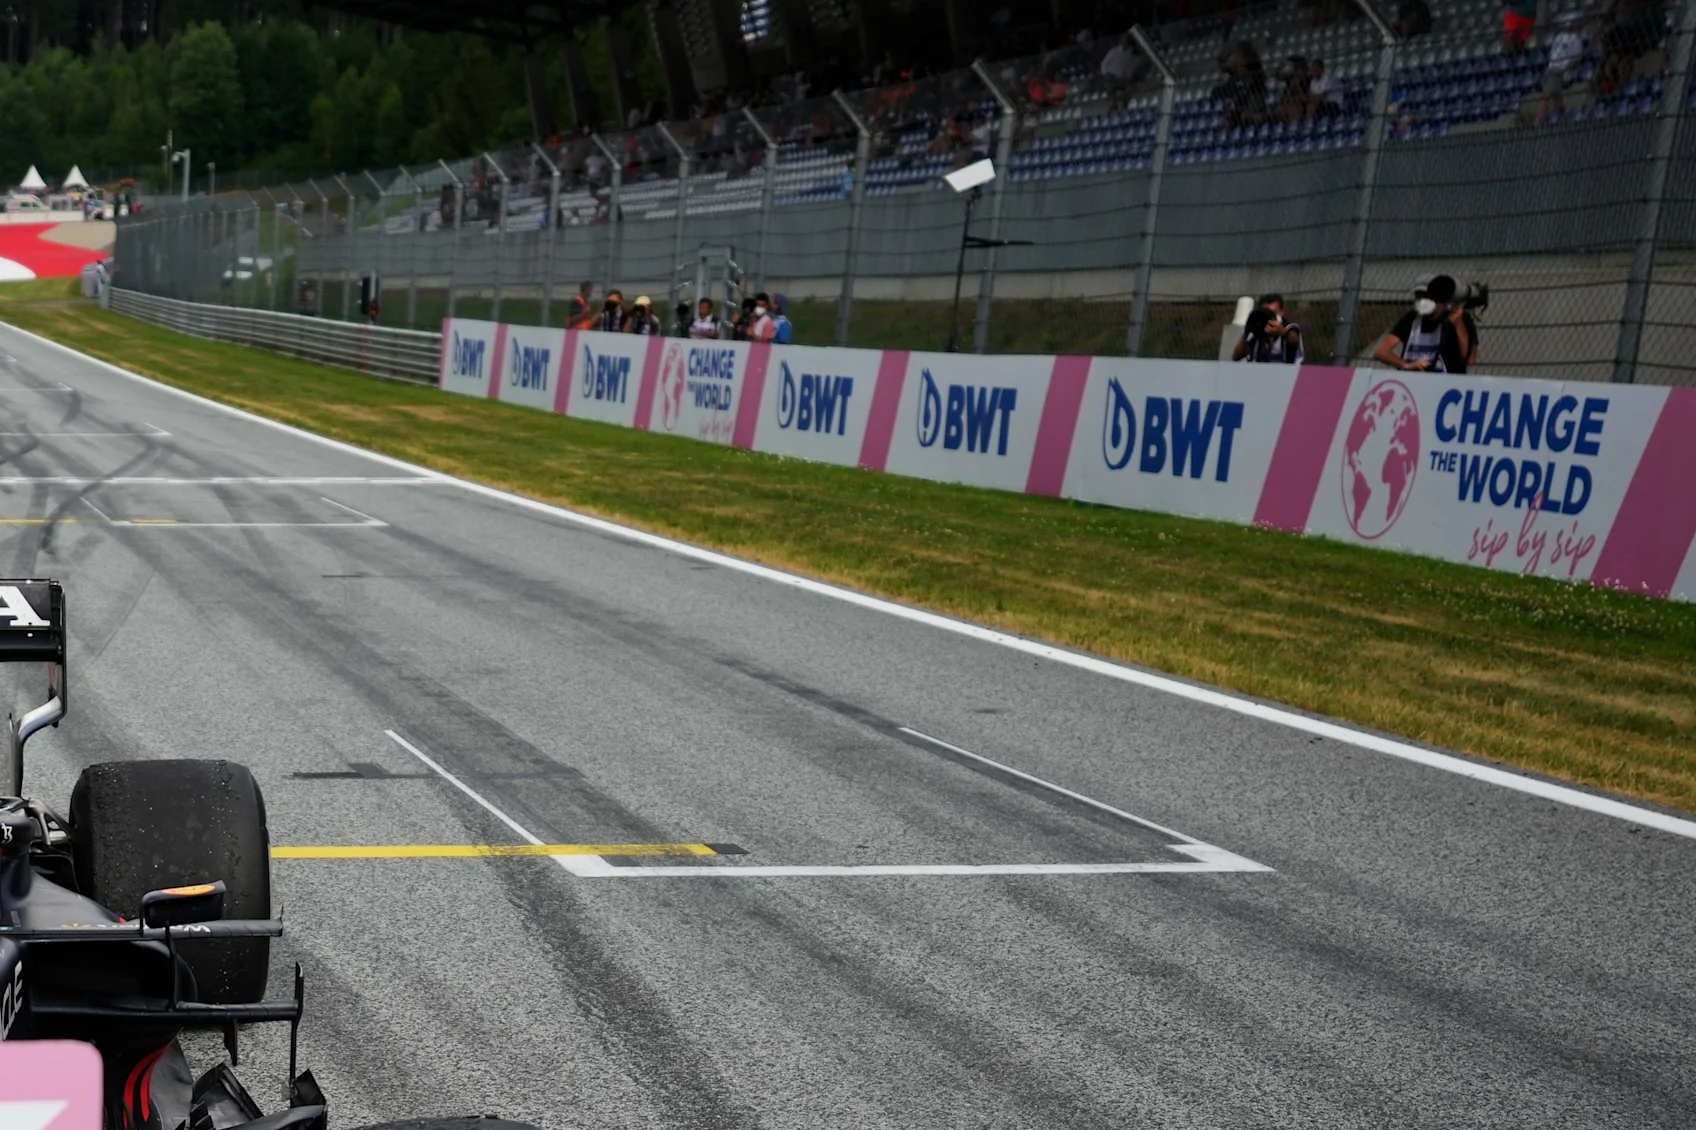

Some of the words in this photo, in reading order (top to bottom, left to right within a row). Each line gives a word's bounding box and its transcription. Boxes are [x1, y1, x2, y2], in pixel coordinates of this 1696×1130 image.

[461, 338, 485, 379] BWT
[521, 347, 550, 391] BWT
[595, 354, 631, 403] BWT
[688, 347, 735, 380] CHANGE
[695, 382, 732, 411] WORLD
[797, 374, 854, 435] BWT
[944, 384, 1017, 456] BWT
[1435, 388, 1610, 456] CHANGE
[1140, 396, 1245, 483] BWT
[1430, 451, 1457, 473] THE
[1457, 453, 1592, 515] WORLD
[1468, 518, 1508, 567] sip
[1516, 491, 1546, 574] by
[1551, 520, 1595, 578] sip
